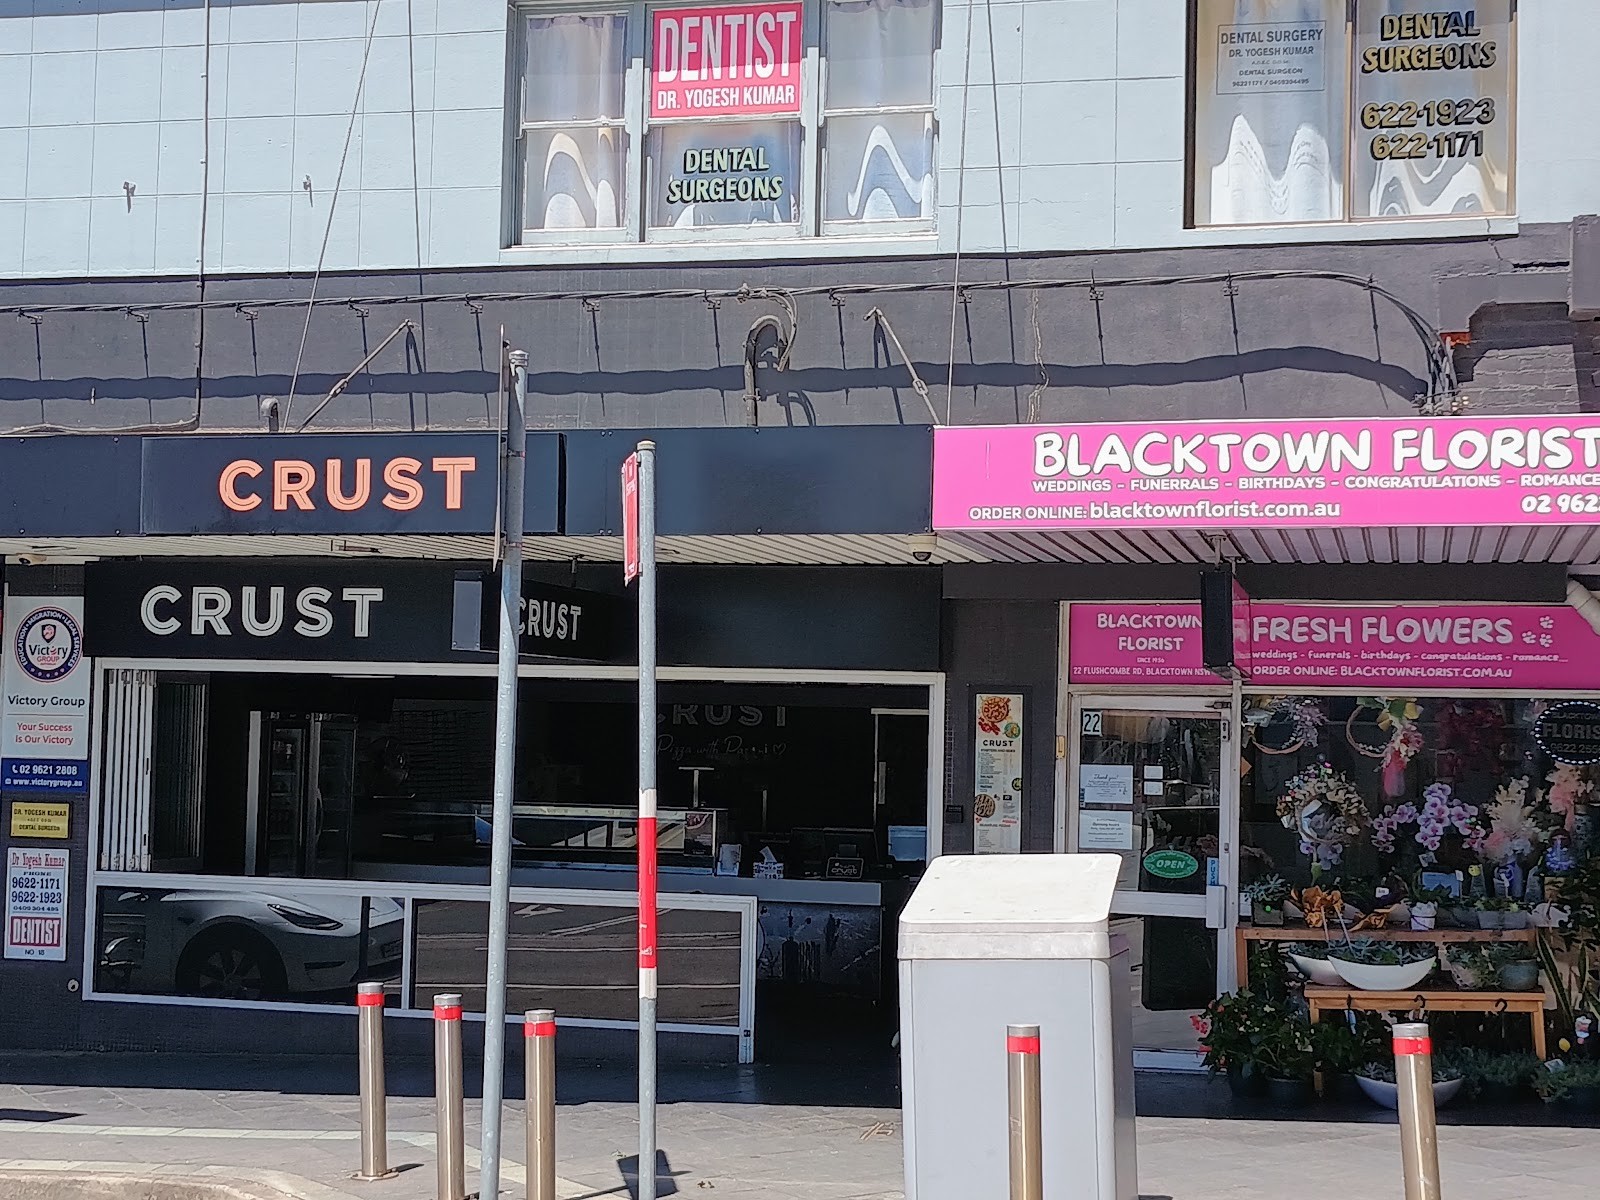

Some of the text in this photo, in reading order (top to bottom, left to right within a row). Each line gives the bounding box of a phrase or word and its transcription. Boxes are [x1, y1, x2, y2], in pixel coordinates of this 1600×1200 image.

[1381, 11, 1481, 41] DENTAL
[1221, 28, 1324, 45] DENTAL SURGERY
[658, 11, 797, 83] DENTIST
[1245, 47, 1281, 57] YOGESH
[1282, 46, 1315, 56] KUMAR
[1361, 42, 1498, 74] SURGEONS
[1267, 67, 1304, 75] SURGEON
[657, 85, 795, 110] DR. YOGESH KUMAR
[1361, 97, 1496, 130] 622-1923
[1371, 130, 1484, 160] 622-1171
[684, 147, 770, 174] DENTAL
[667, 176, 784, 204] SURGEONS
[1033, 426, 1600, 477] BLACKTOWN FLORIST
[217, 456, 477, 513] CRUST
[1032, 479, 1112, 492] WEDDINGS
[1130, 478, 1219, 491] FUNERRALS
[1238, 476, 1326, 490] BIRTHDAYS
[1344, 474, 1502, 489] CONGRATULATIONS
[969, 500, 1341, 520] ORDER ONLINE: blacktownflorist.com.au
[1521, 493, 1600, 514] 02 962
[27, 611, 62, 626] MIGRATION
[140, 585, 384, 638] CRUST
[63, 618, 78, 636] LEGAL
[1097, 613, 1202, 629] BLACKTOWN
[1252, 616, 1351, 644] FRESH
[1361, 616, 1513, 645] FLOWERS
[28, 644, 68, 659] Victory
[67, 636, 81, 667] SERVICES
[1118, 637, 1184, 651] FLORIST
[1252, 649, 1298, 661] weddings
[1307, 650, 1351, 660] funerals
[1360, 650, 1411, 663] birthdays
[1421, 652, 1503, 663] congratulations
[1083, 667, 1131, 675] FLUSHCOMBE
[1146, 667, 1193, 676] BLACKTOWN
[1253, 665, 1291, 676] ORDER
[1340, 665, 1513, 678] BLACKTOWNFLORIST.COM.AU
[8, 695, 86, 708] Victory Group
[17, 722, 73, 732] Your Success
[1083, 713, 1100, 733] 22
[15, 735, 74, 746] Is Our Victory
[982, 739, 1014, 747] CRUST
[19, 764, 78, 775] 02 9621 2808
[13, 778, 83, 787] www.victorygroup.au
[12, 852, 66, 870] Dr Yogesh Kumar
[1156, 860, 1186, 869] OPEN
[12, 876, 60, 890] 9622-1171
[11, 890, 62, 904] 9622-1923
[12, 918, 60, 945] DENTIST
